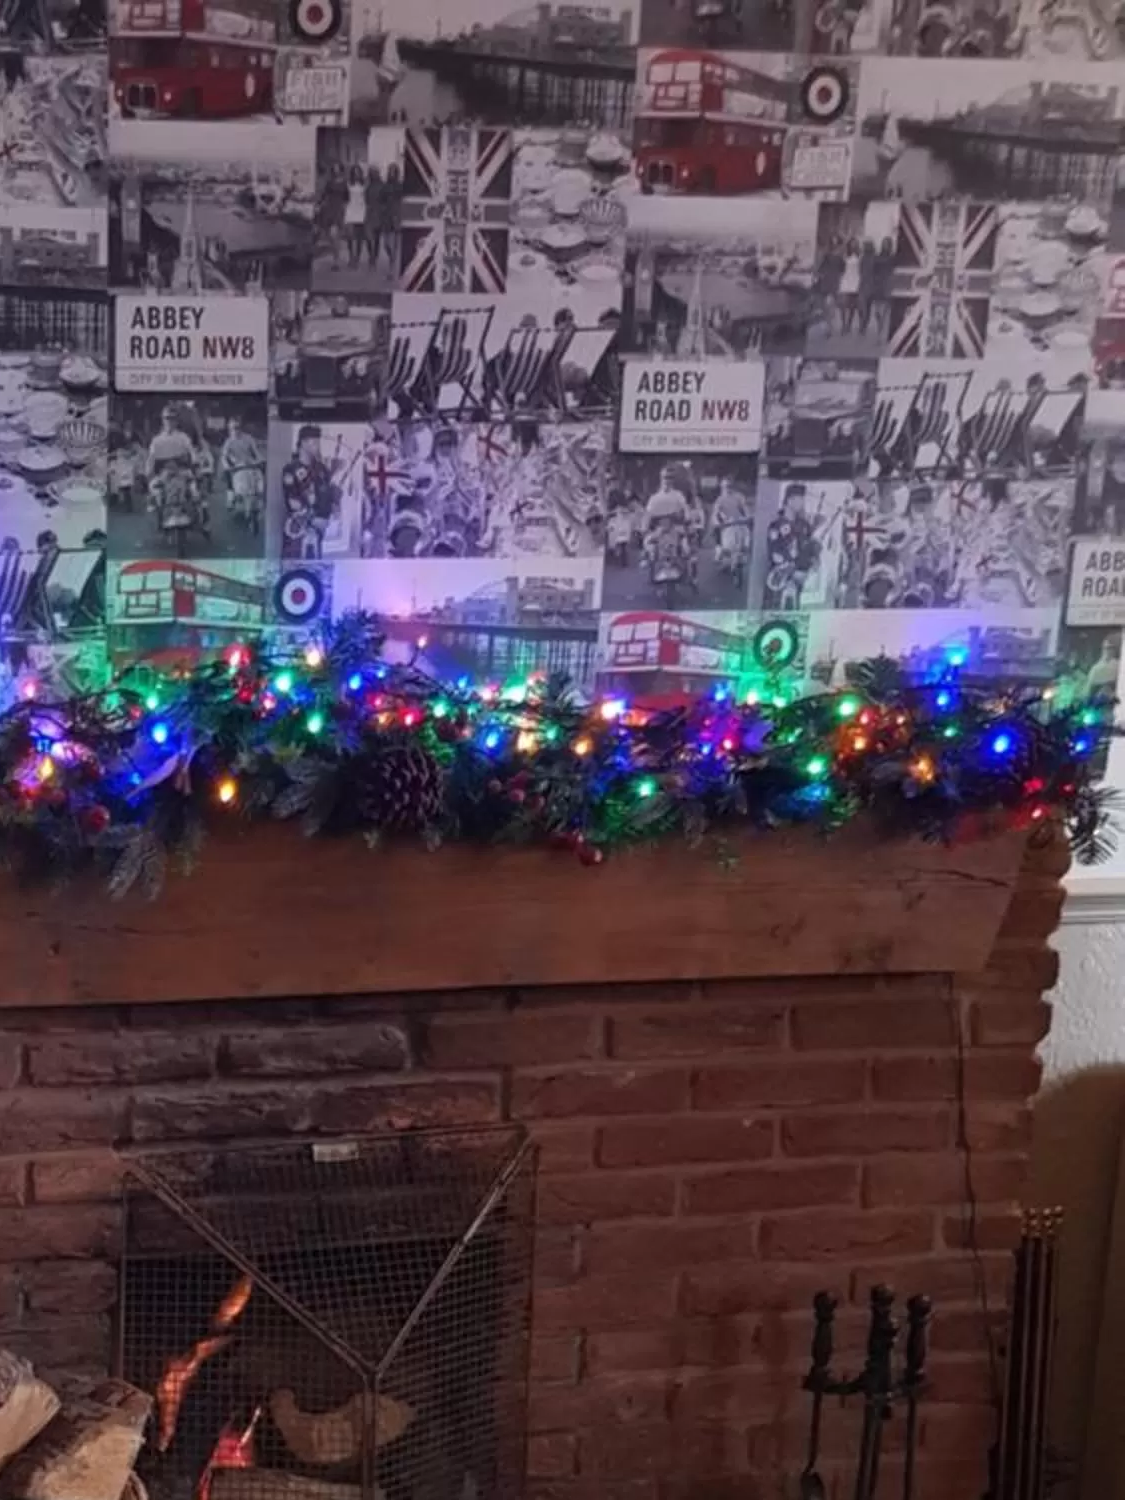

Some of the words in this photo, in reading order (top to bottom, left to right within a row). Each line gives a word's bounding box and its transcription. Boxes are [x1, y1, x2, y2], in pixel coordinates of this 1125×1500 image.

[131, 305, 204, 330] ABBEY
[130, 335, 191, 360] ROAD
[202, 335, 255, 360] NW8
[637, 370, 706, 394] ABBEY
[634, 399, 692, 422] ROAD
[700, 399, 751, 422] NW8
[1084, 550, 1125, 572] ABB
[1081, 576, 1125, 597] ROA
